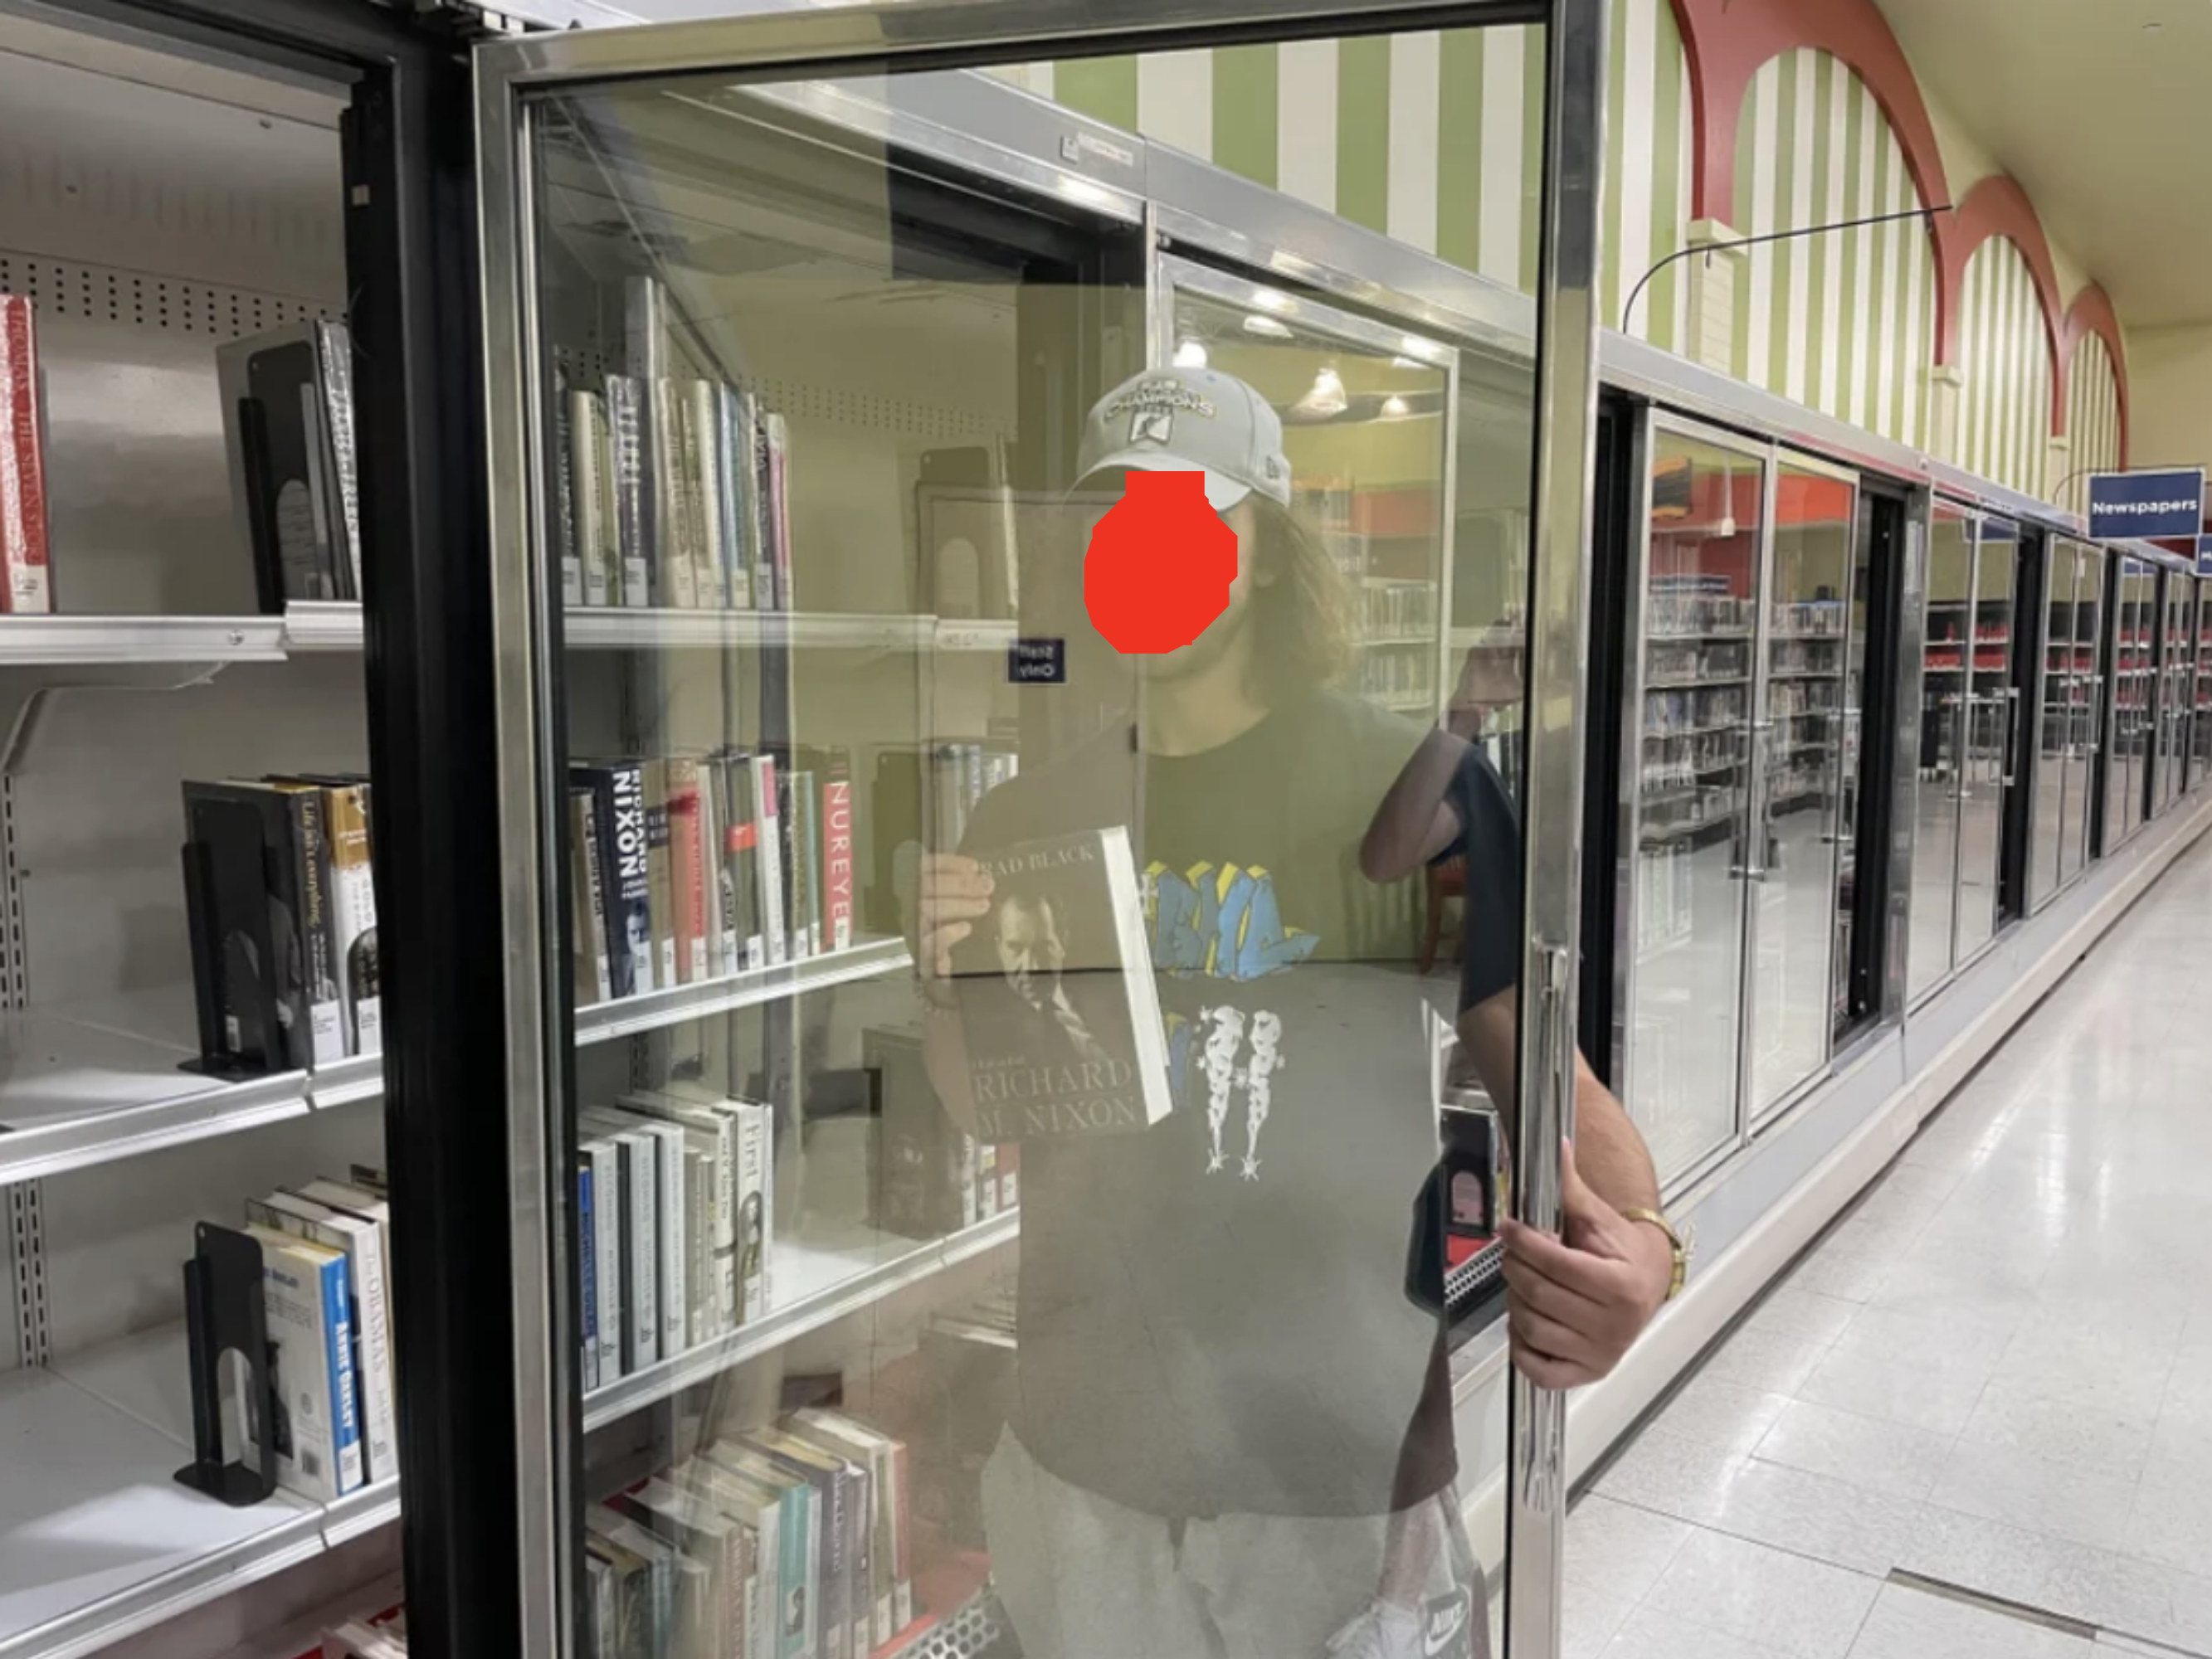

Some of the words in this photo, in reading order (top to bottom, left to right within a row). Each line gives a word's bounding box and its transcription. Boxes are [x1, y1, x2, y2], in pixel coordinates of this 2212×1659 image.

[2092, 499, 2198, 515] Newspapers
[28, 513, 45, 564] STOR
[303, 801, 315, 826] Life
[613, 771, 639, 878] NIXON
[631, 769, 647, 873] RICHARD
[1029, 844, 1094, 870] BLACK
[973, 1058, 1133, 1102] RICHARD
[1025, 1097, 1136, 1136] NIXON
[1430, 1601, 1464, 1637] NIKE
